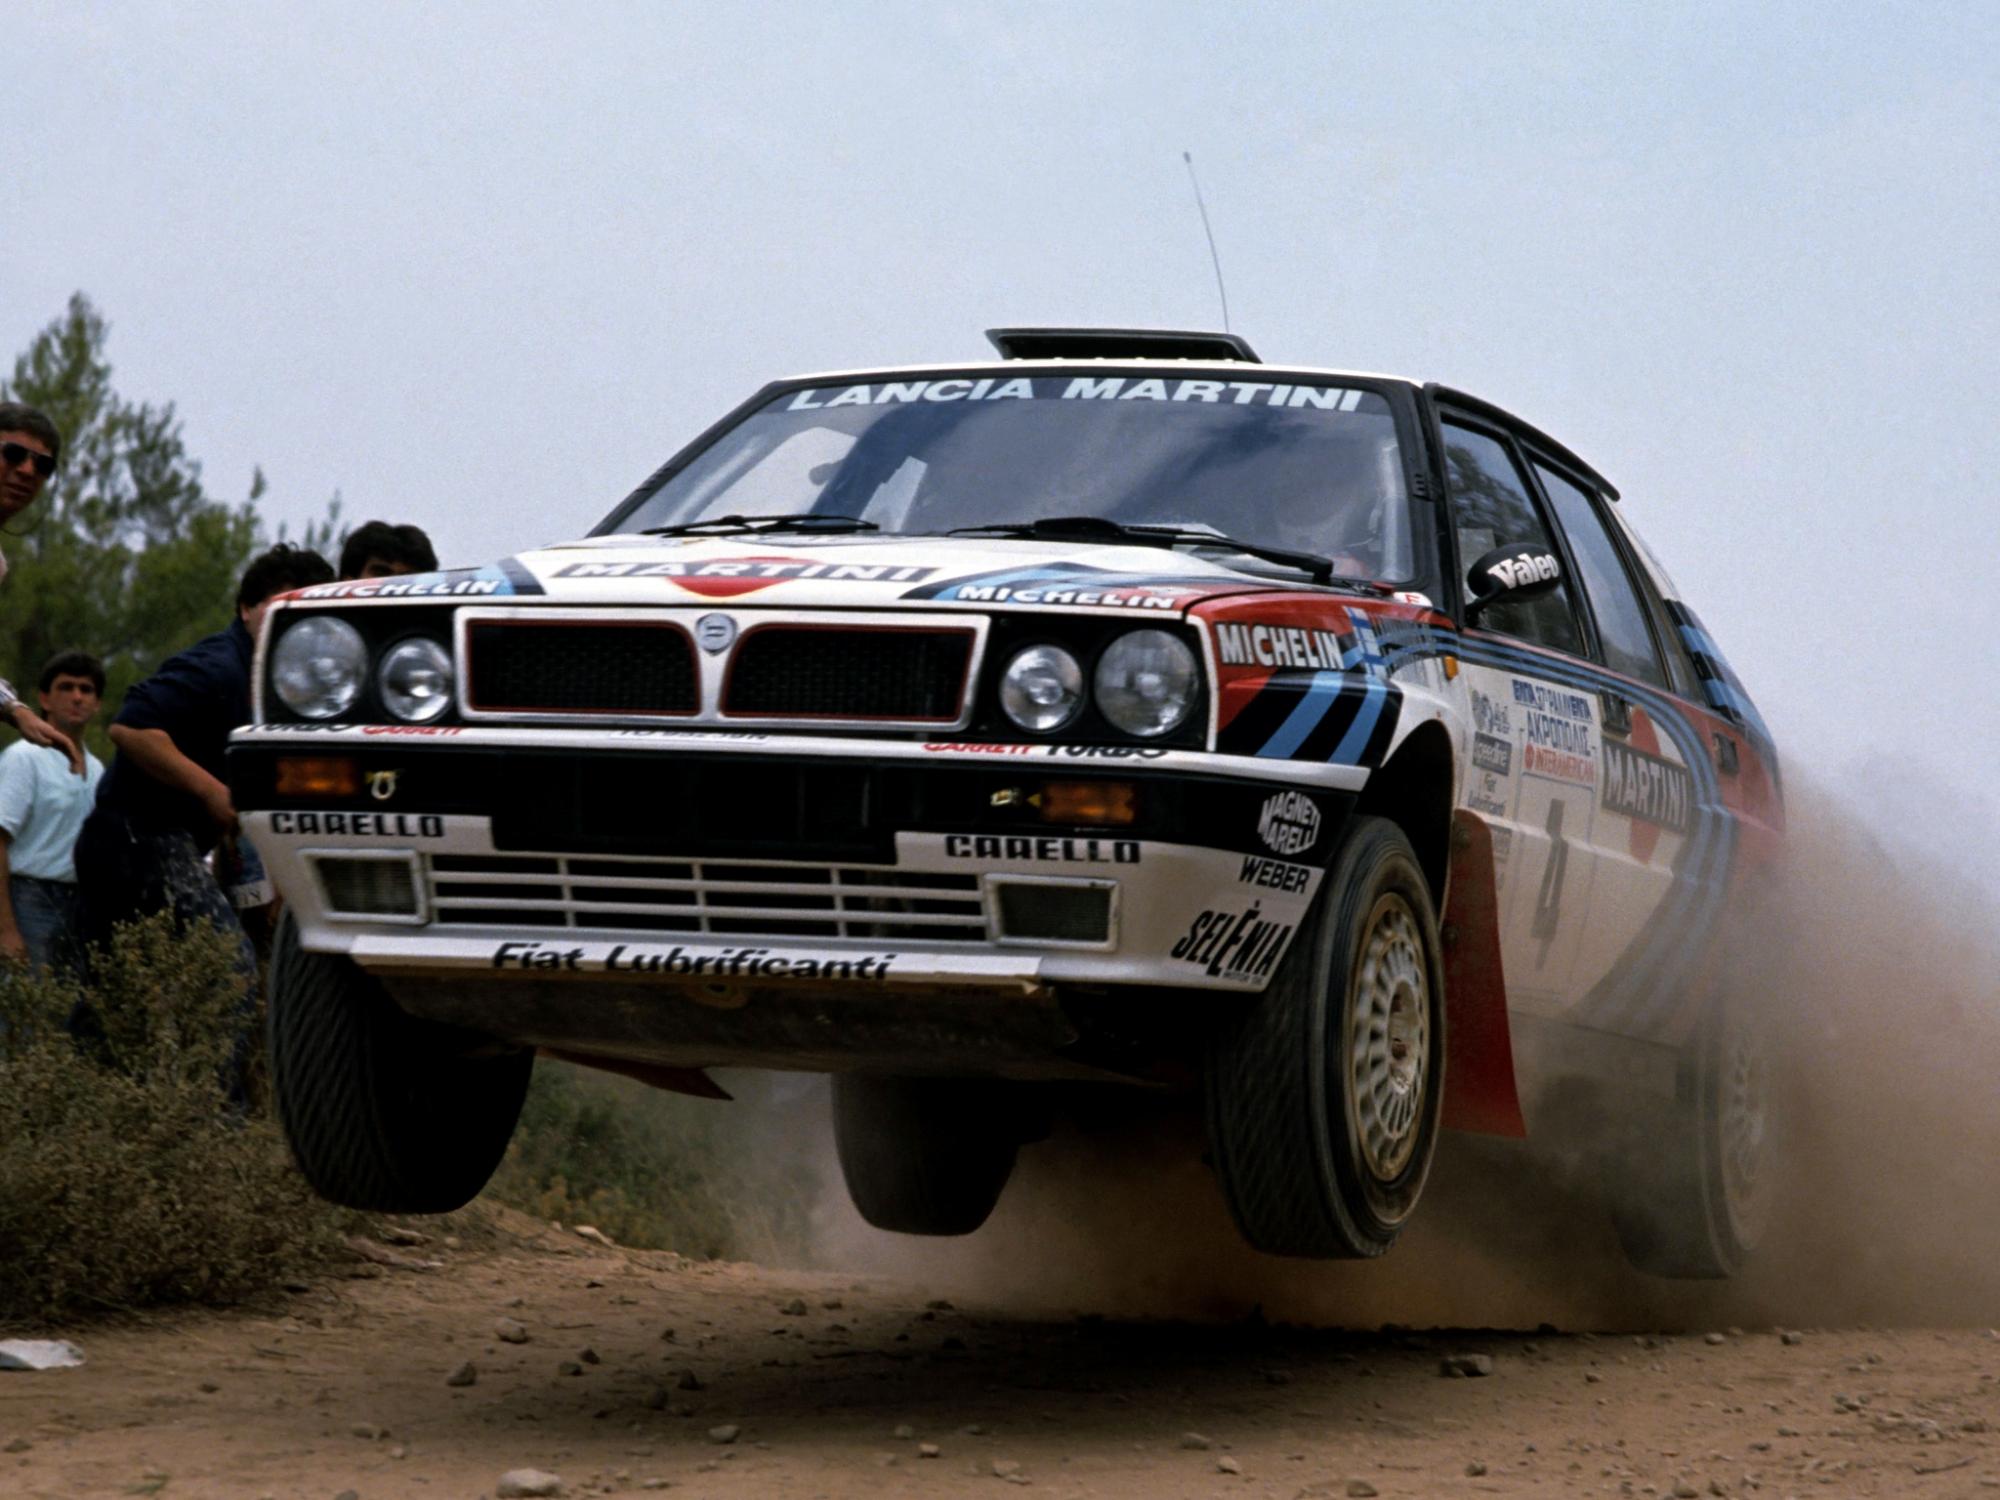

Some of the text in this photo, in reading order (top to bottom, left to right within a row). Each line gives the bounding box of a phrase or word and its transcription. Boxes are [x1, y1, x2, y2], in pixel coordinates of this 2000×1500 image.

[787, 376, 1363, 413] LANCIA MARTINI
[566, 562, 925, 581] MARTINI
[1487, 553, 1559, 589] Valeo
[303, 579, 500, 600] MICHELIN
[957, 585, 1174, 609] MICHELIN
[1215, 622, 1345, 670] MICHELIN
[1604, 744, 1688, 828] MARTINI
[269, 812, 446, 838] CARELLO
[944, 835, 1141, 864] CARELLO
[1239, 856, 1311, 895] WEBER
[493, 942, 898, 981] Fiat Lubrificanti
